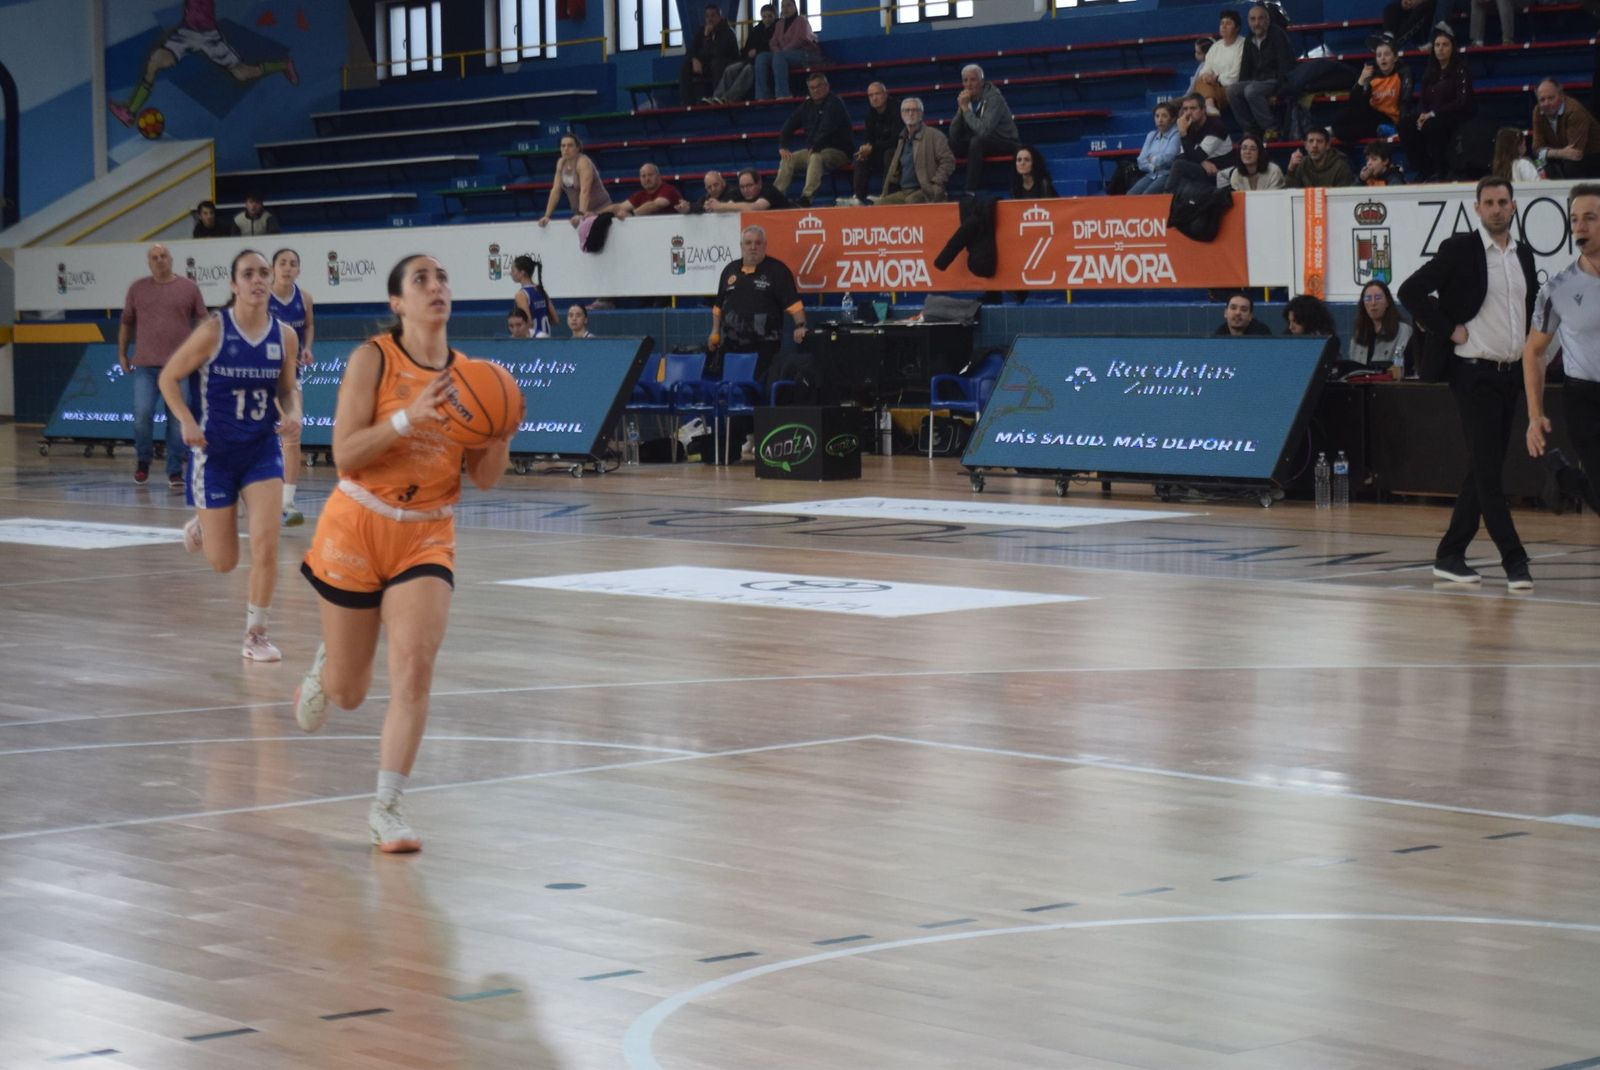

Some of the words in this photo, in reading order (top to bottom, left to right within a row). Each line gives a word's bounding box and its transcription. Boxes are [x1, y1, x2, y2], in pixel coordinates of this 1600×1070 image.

[1091, 140, 1107, 151] FILA
[687, 245, 734, 264] ZAMORA
[340, 259, 377, 276] ZAMORA
[836, 258, 933, 288] ZAMORA
[1066, 252, 1178, 285] ZAMORA
[232, 389, 268, 421] 13
[995, 429, 1036, 444] MÁS
[1113, 433, 1158, 449] MÁS
[397, 484, 419, 503] 3
